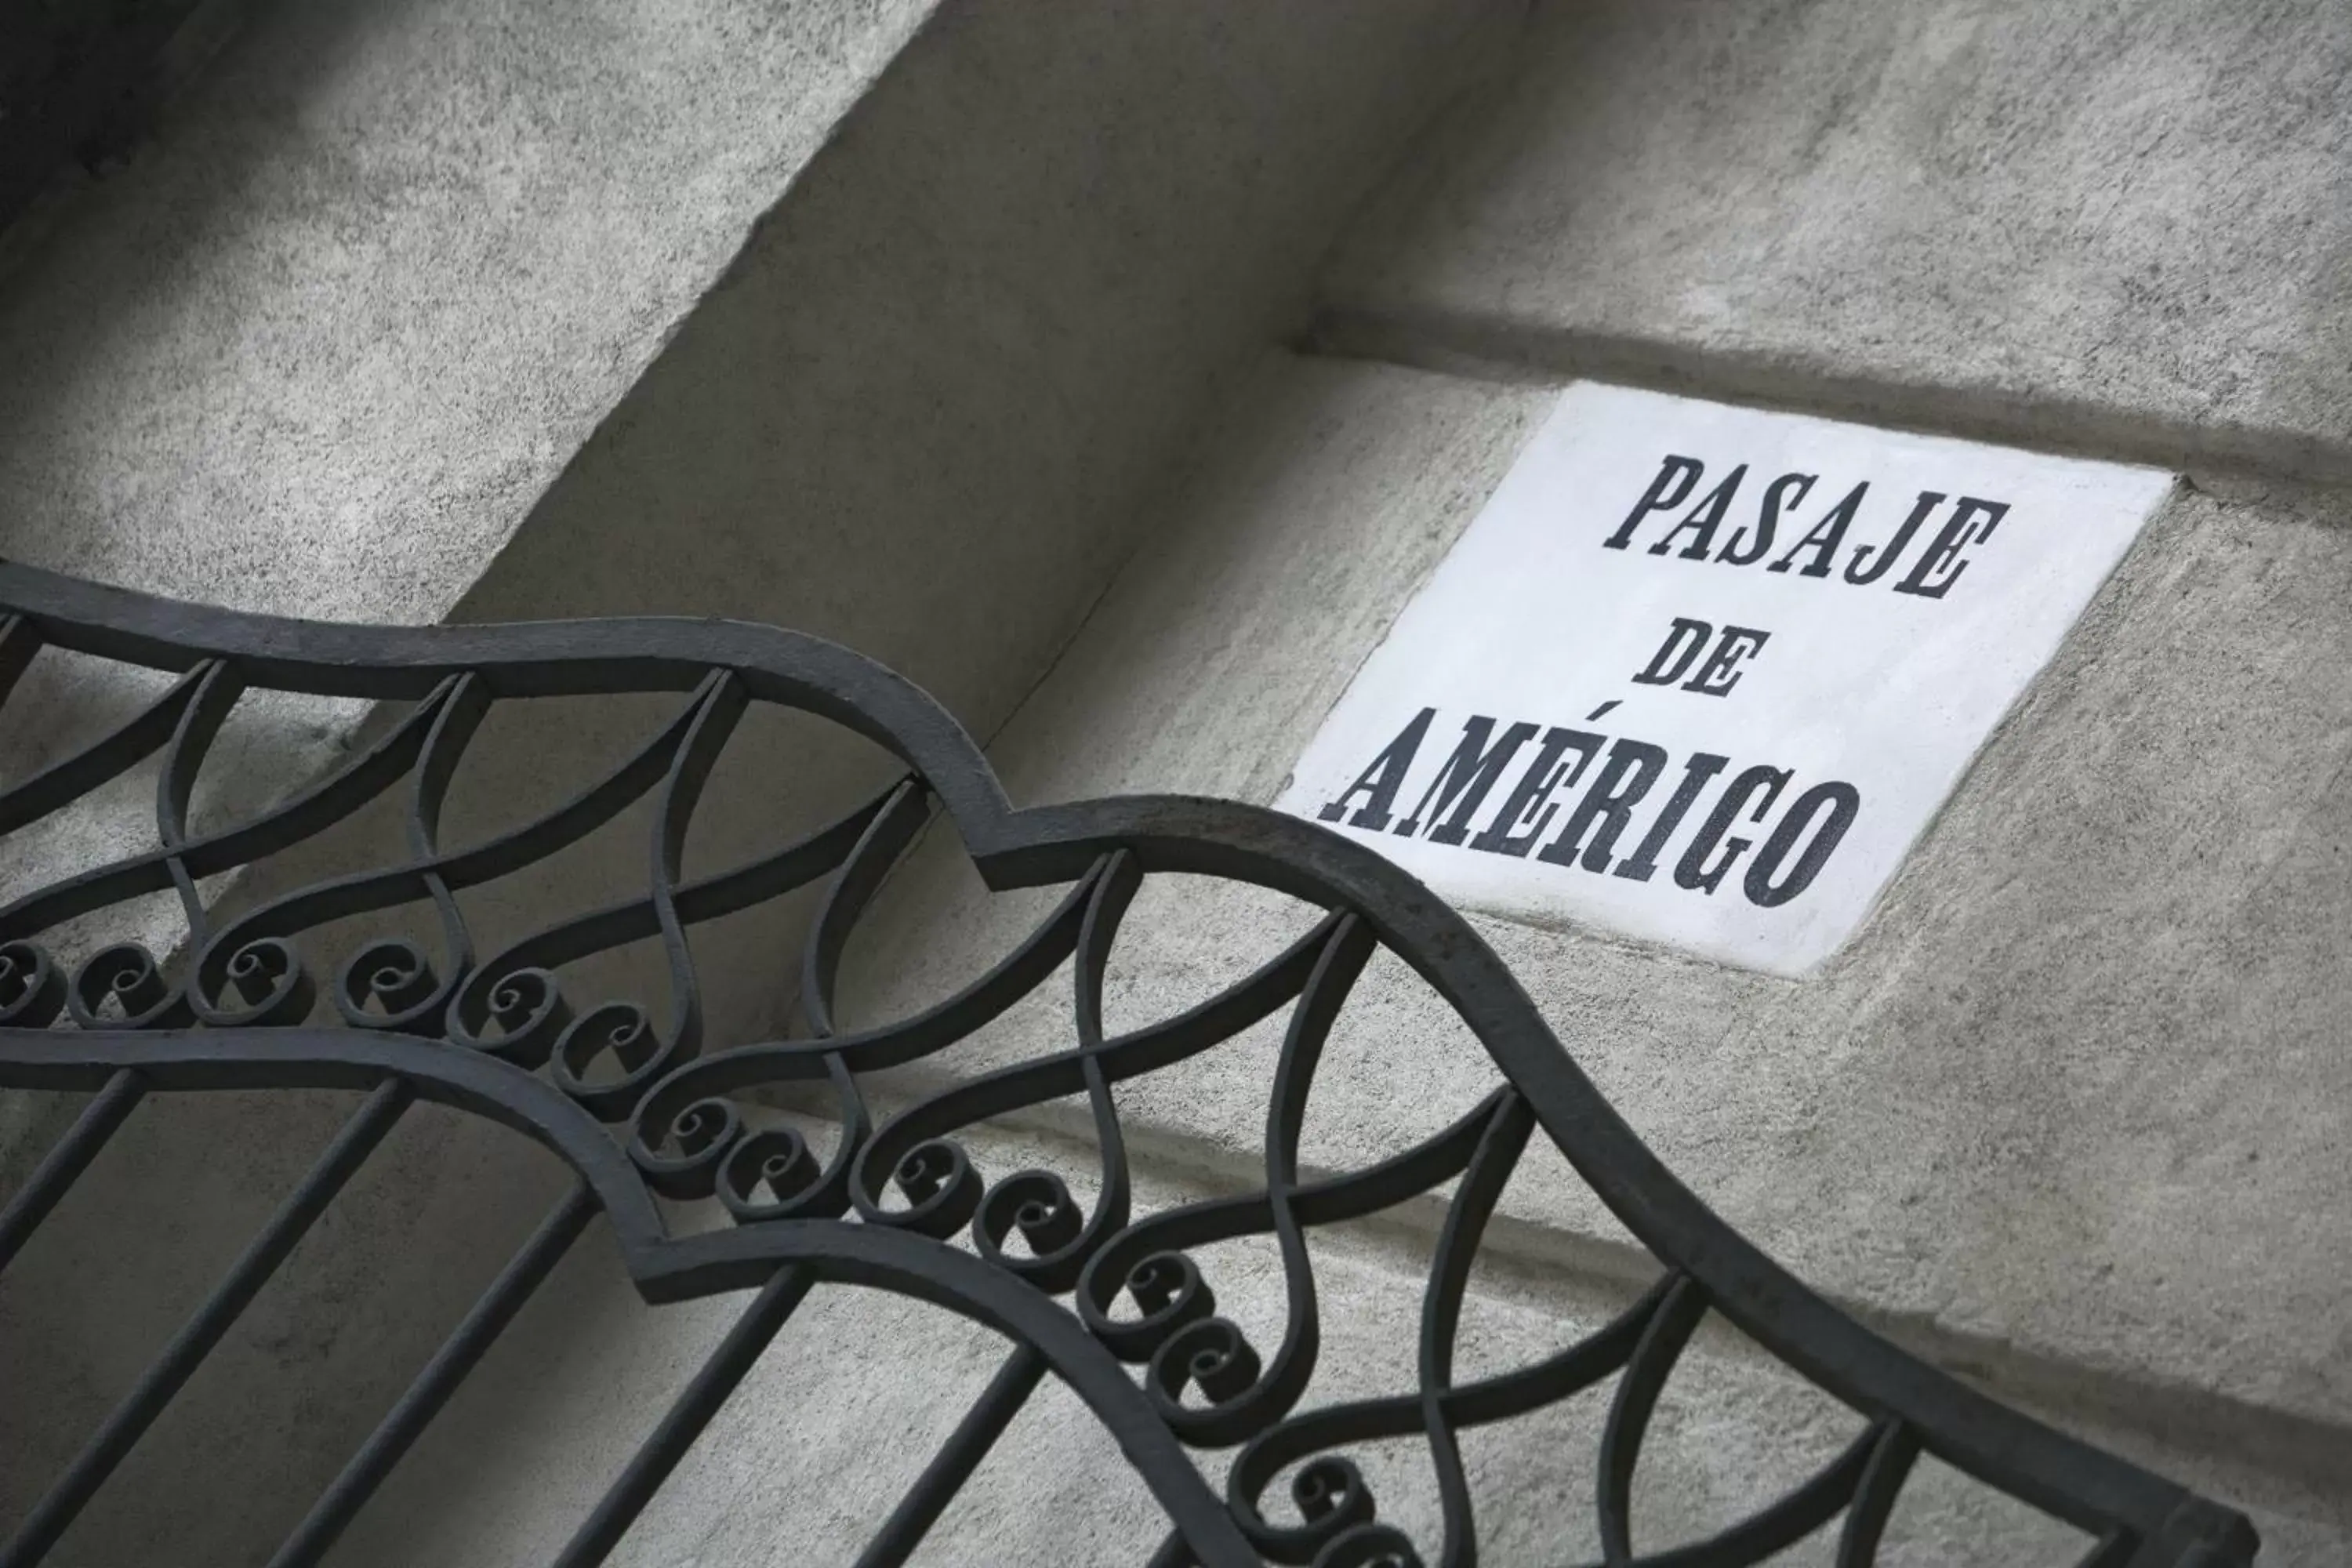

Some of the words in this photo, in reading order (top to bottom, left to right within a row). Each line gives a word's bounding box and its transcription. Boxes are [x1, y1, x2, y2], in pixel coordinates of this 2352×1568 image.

[1602, 454, 2012, 600] PASAJE
[1631, 617, 1771, 698] DE
[1316, 700, 1860, 908] AMÉRIGO
